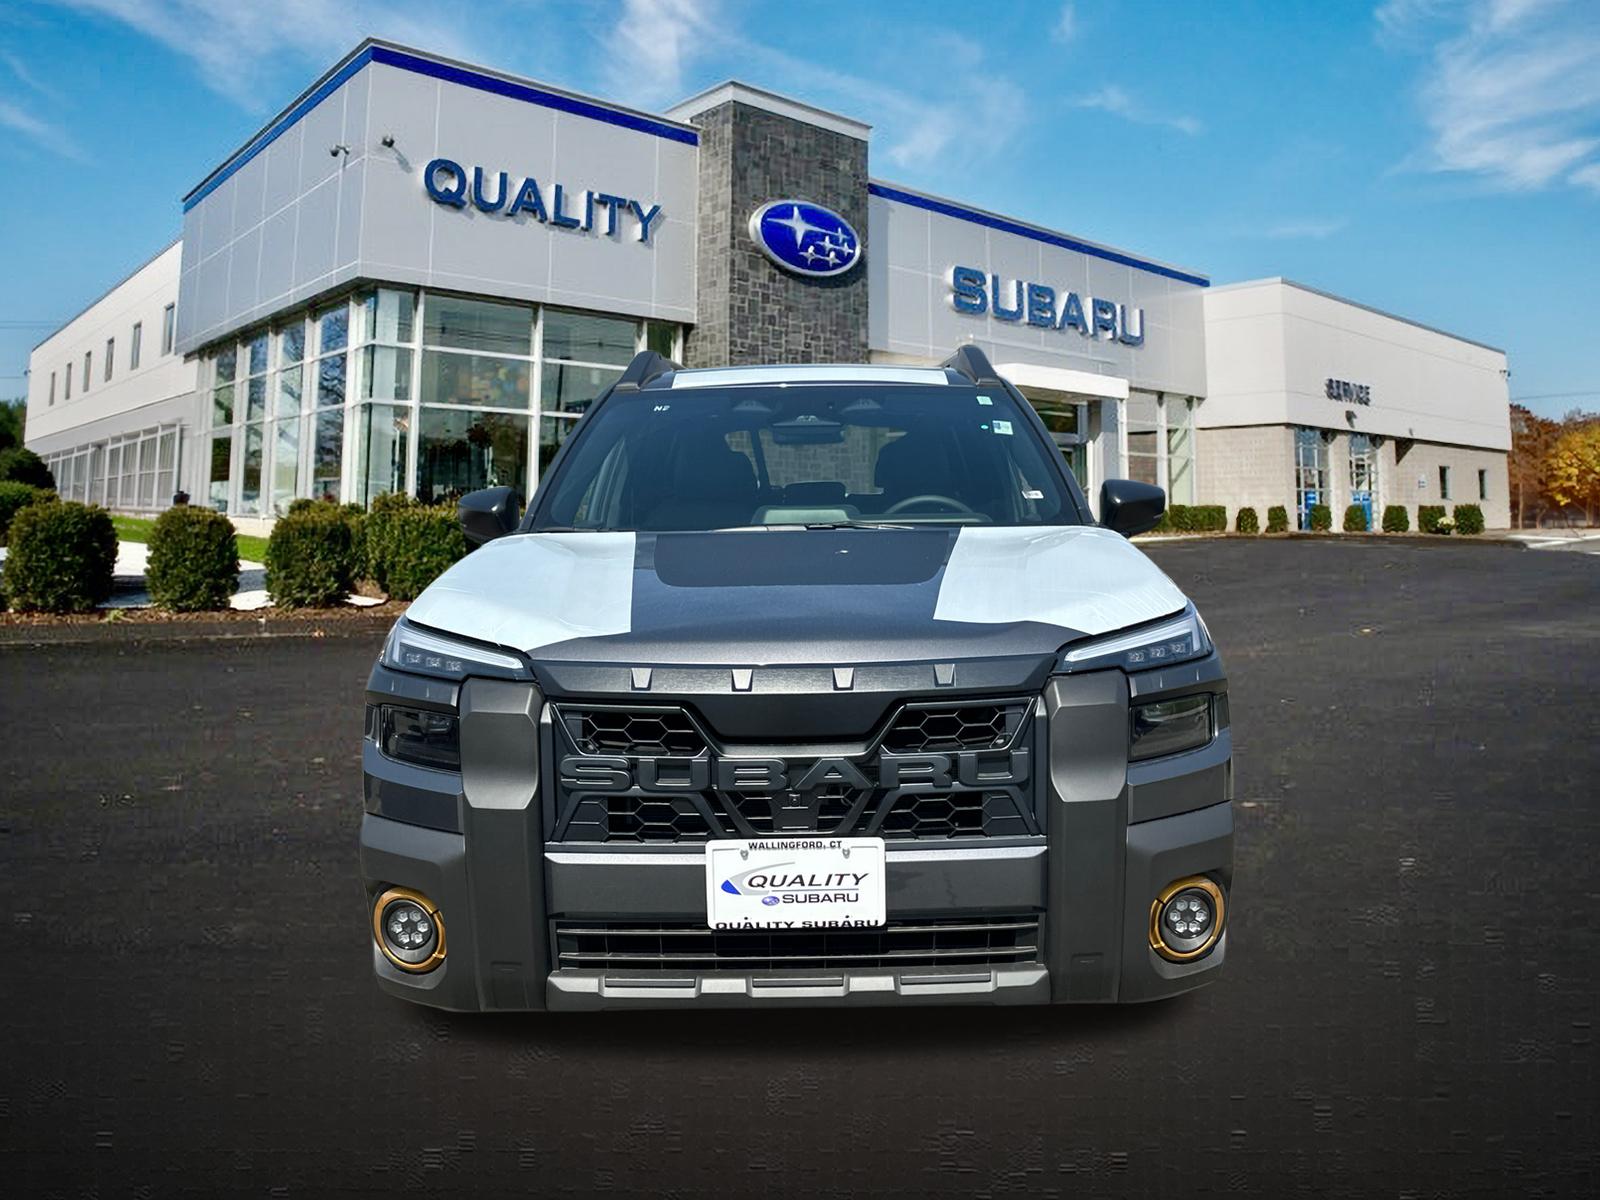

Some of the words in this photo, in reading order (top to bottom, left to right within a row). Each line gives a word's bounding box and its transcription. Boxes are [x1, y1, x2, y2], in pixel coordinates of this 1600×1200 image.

[424, 158, 662, 242] QUALITY
[950, 264, 1145, 346] SUBARU
[559, 747, 1031, 791] SUBARU
[748, 841, 826, 850] WALLINGFORD,
[829, 840, 843, 849] CT
[747, 873, 869, 888] QUALITY
[782, 893, 859, 904] SUBARU
[715, 921, 795, 929] QUALITY
[801, 919, 879, 928] SUBARU
